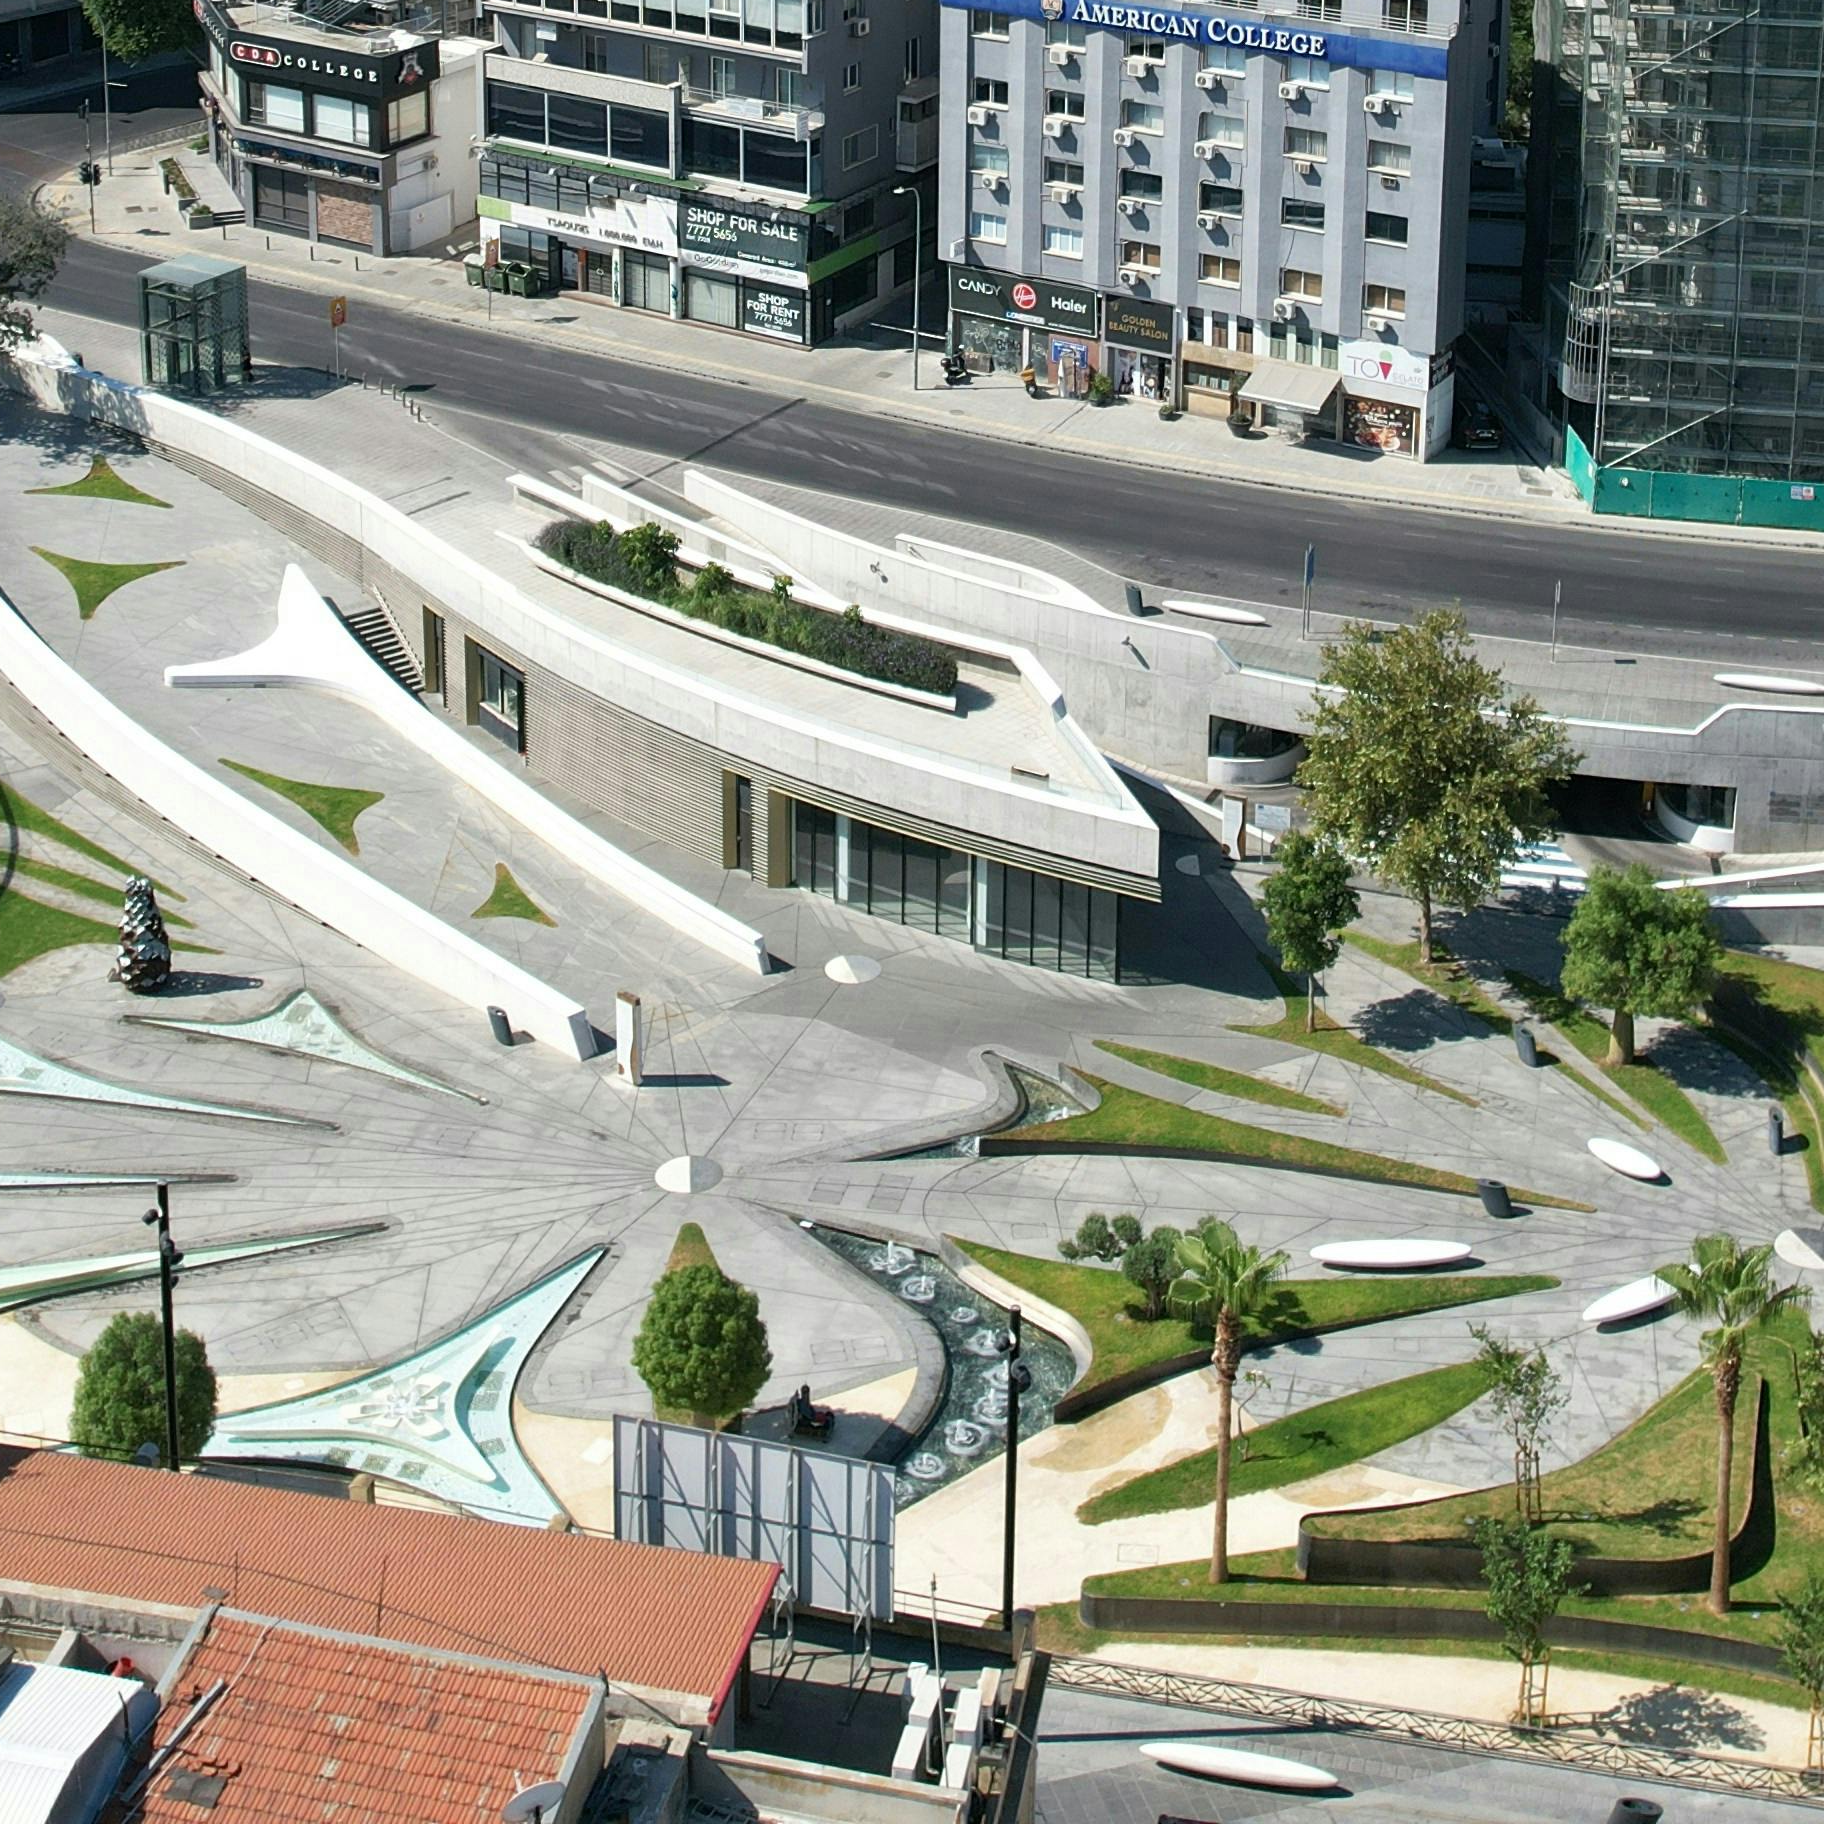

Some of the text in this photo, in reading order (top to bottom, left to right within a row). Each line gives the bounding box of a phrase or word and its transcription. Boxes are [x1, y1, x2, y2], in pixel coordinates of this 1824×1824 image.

[1207, 18, 1325, 57] COLLEGE
[283, 56, 377, 82] COLLEGE
[686, 223, 711, 237] 7777
[713, 227, 738, 242] 5656
[687, 207, 798, 242] SHOP FOR SALE
[958, 278, 1002, 296] CANDY
[758, 292, 789, 307] SHOP
[1051, 296, 1087, 314] Haier
[747, 299, 800, 320] FOR RENT
[754, 311, 772, 322] 7777
[773, 315, 793, 327] 5656
[1108, 321, 1138, 334] BEAUTY
[1140, 328, 1168, 341] SALON
[1121, 314, 1156, 329] GOLDEN
